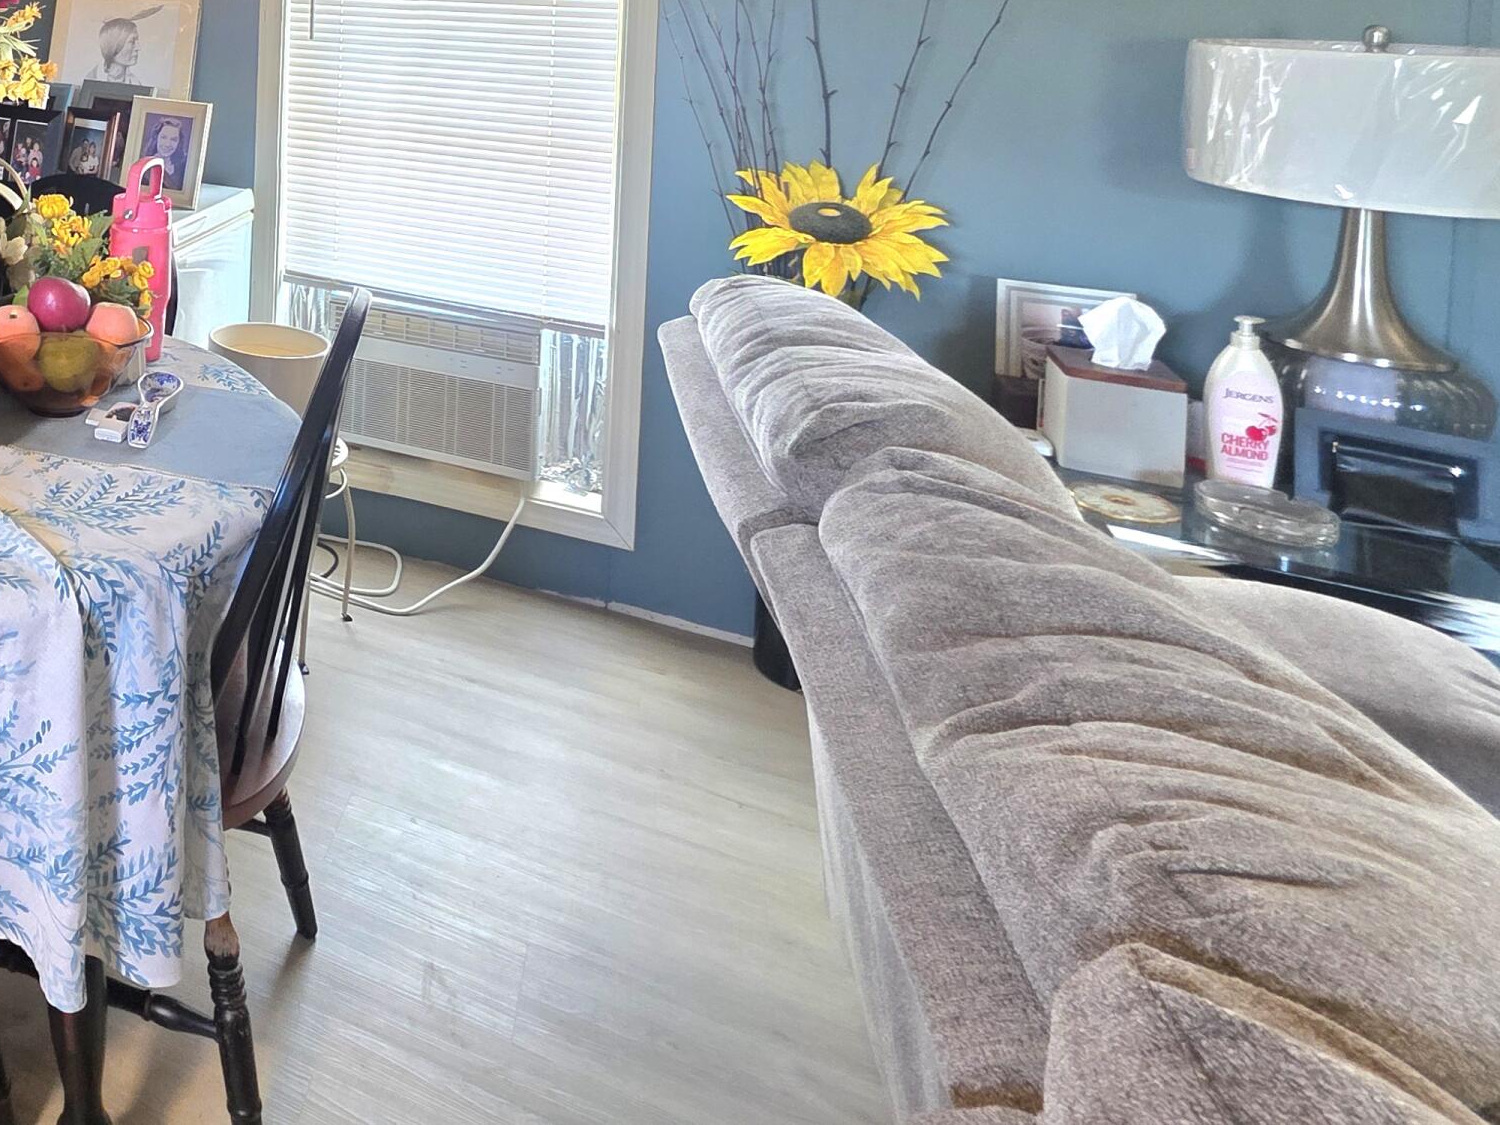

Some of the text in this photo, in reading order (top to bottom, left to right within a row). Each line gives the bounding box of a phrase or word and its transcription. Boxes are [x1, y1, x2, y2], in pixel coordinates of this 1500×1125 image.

[1222, 388, 1274, 404] JERGENS
[1221, 432, 1269, 451] CHERRY
[1221, 444, 1269, 461] ALMOND
